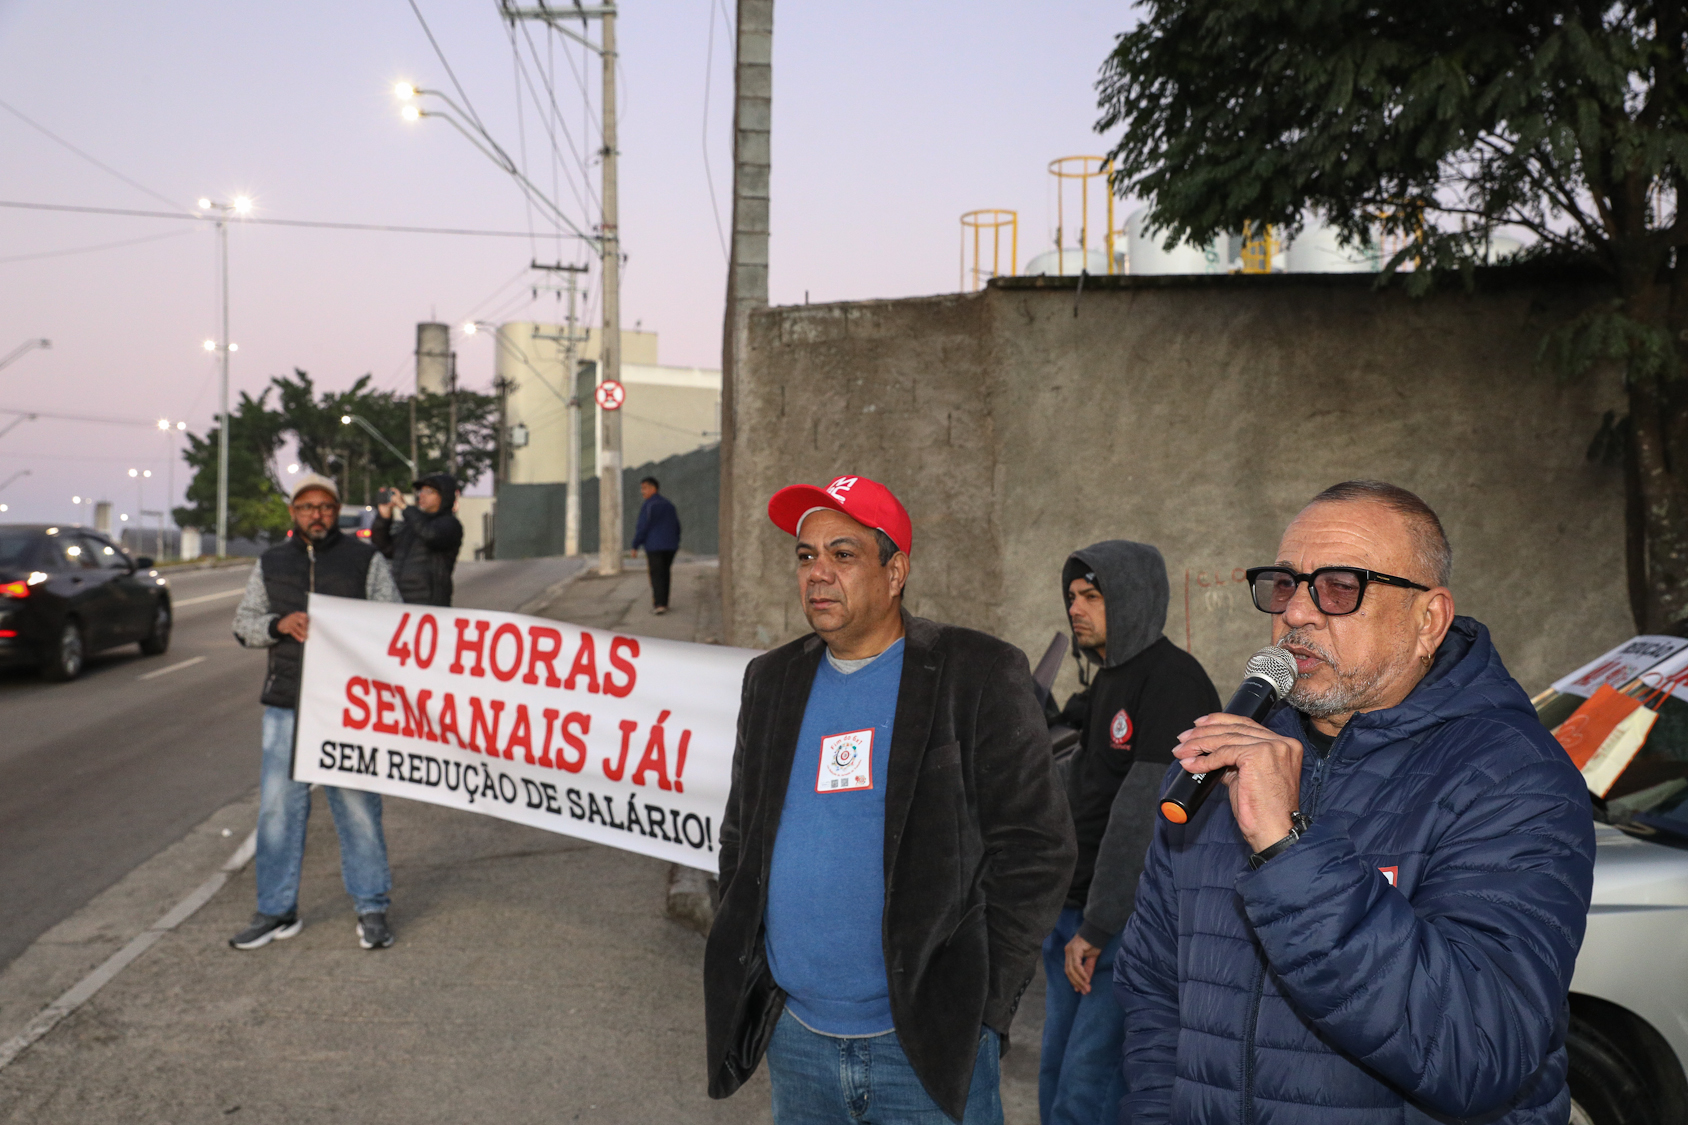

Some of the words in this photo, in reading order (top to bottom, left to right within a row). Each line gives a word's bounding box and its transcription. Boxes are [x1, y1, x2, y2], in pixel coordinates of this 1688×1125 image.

[387, 612, 438, 669] 40
[449, 617, 640, 698] HORAS
[342, 675, 592, 774] SEMANAIS
[602, 709, 693, 794] JÁ!
[319, 740, 379, 777] SEM
[387, 749, 518, 804] REDUÇÃO
[526, 777, 562, 815] DE
[566, 788, 714, 852] SALÁRIO!
